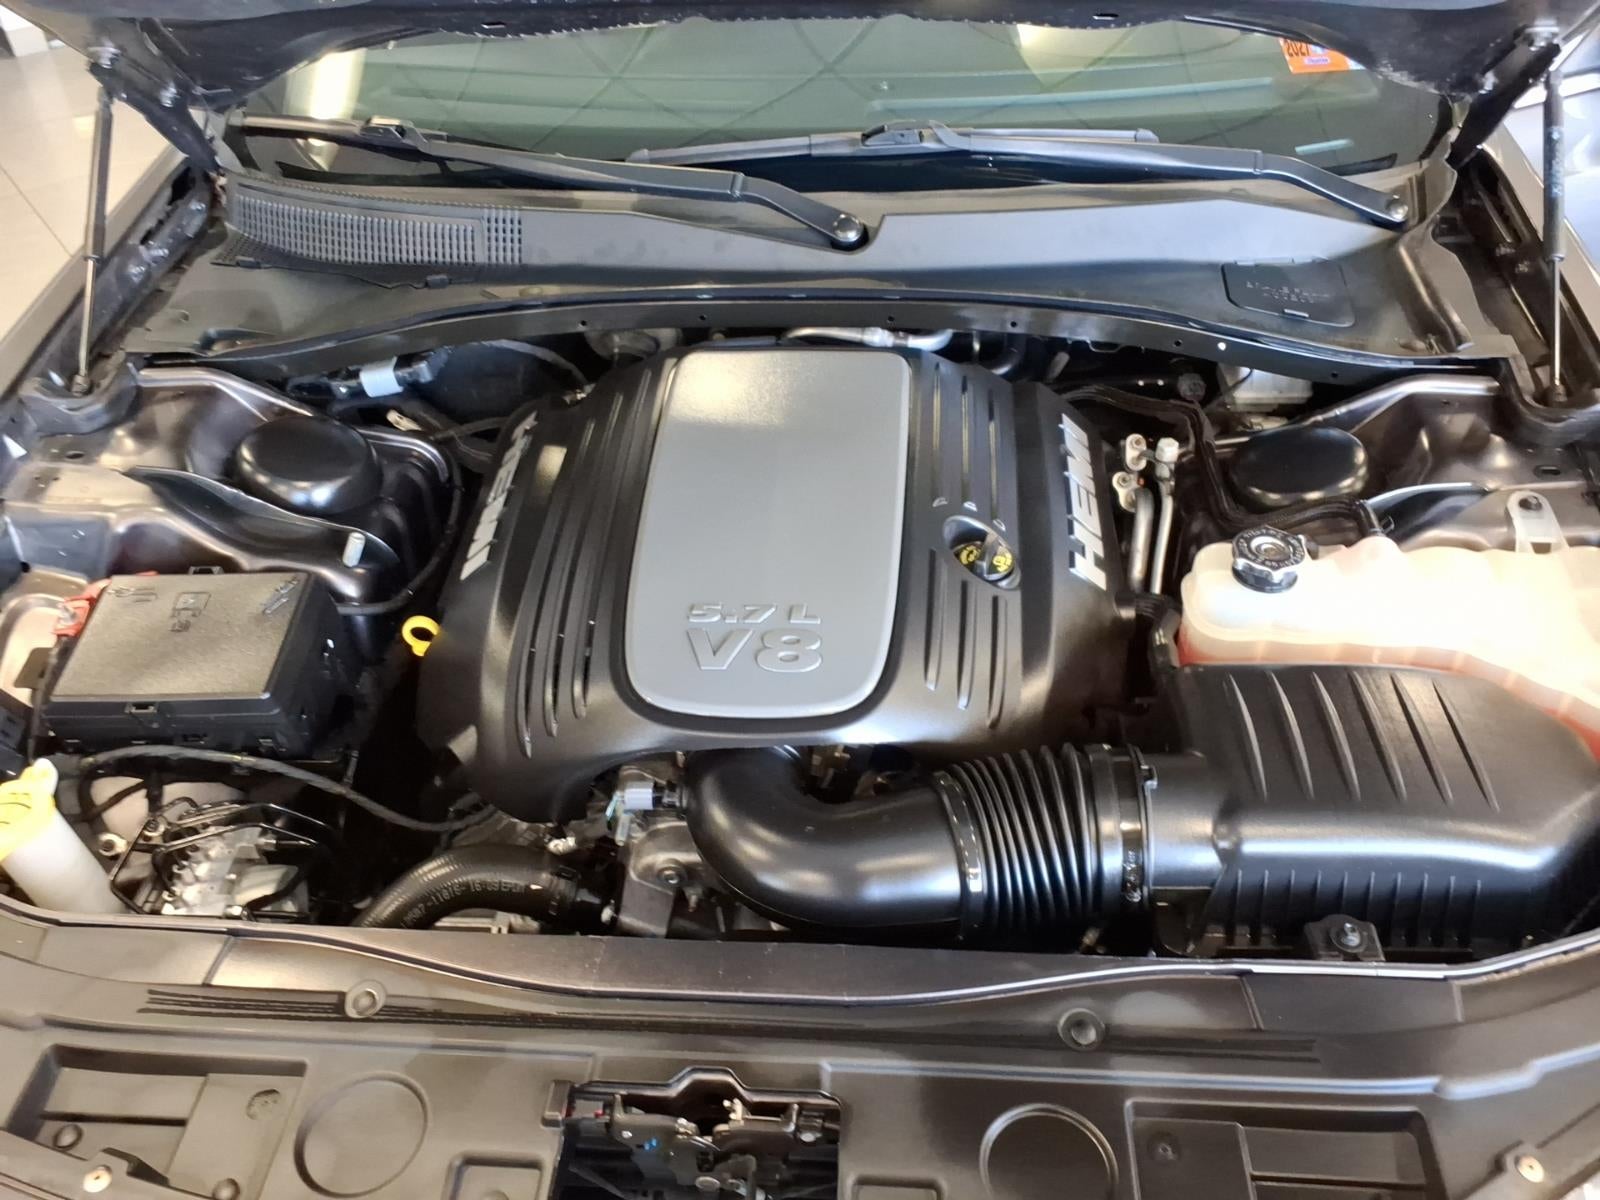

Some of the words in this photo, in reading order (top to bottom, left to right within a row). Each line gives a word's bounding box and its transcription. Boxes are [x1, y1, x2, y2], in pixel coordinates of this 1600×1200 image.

[1058, 413, 1107, 591] HEMI
[687, 603, 777, 624] 5.7
[788, 603, 821, 624] L
[686, 628, 823, 673] V8
